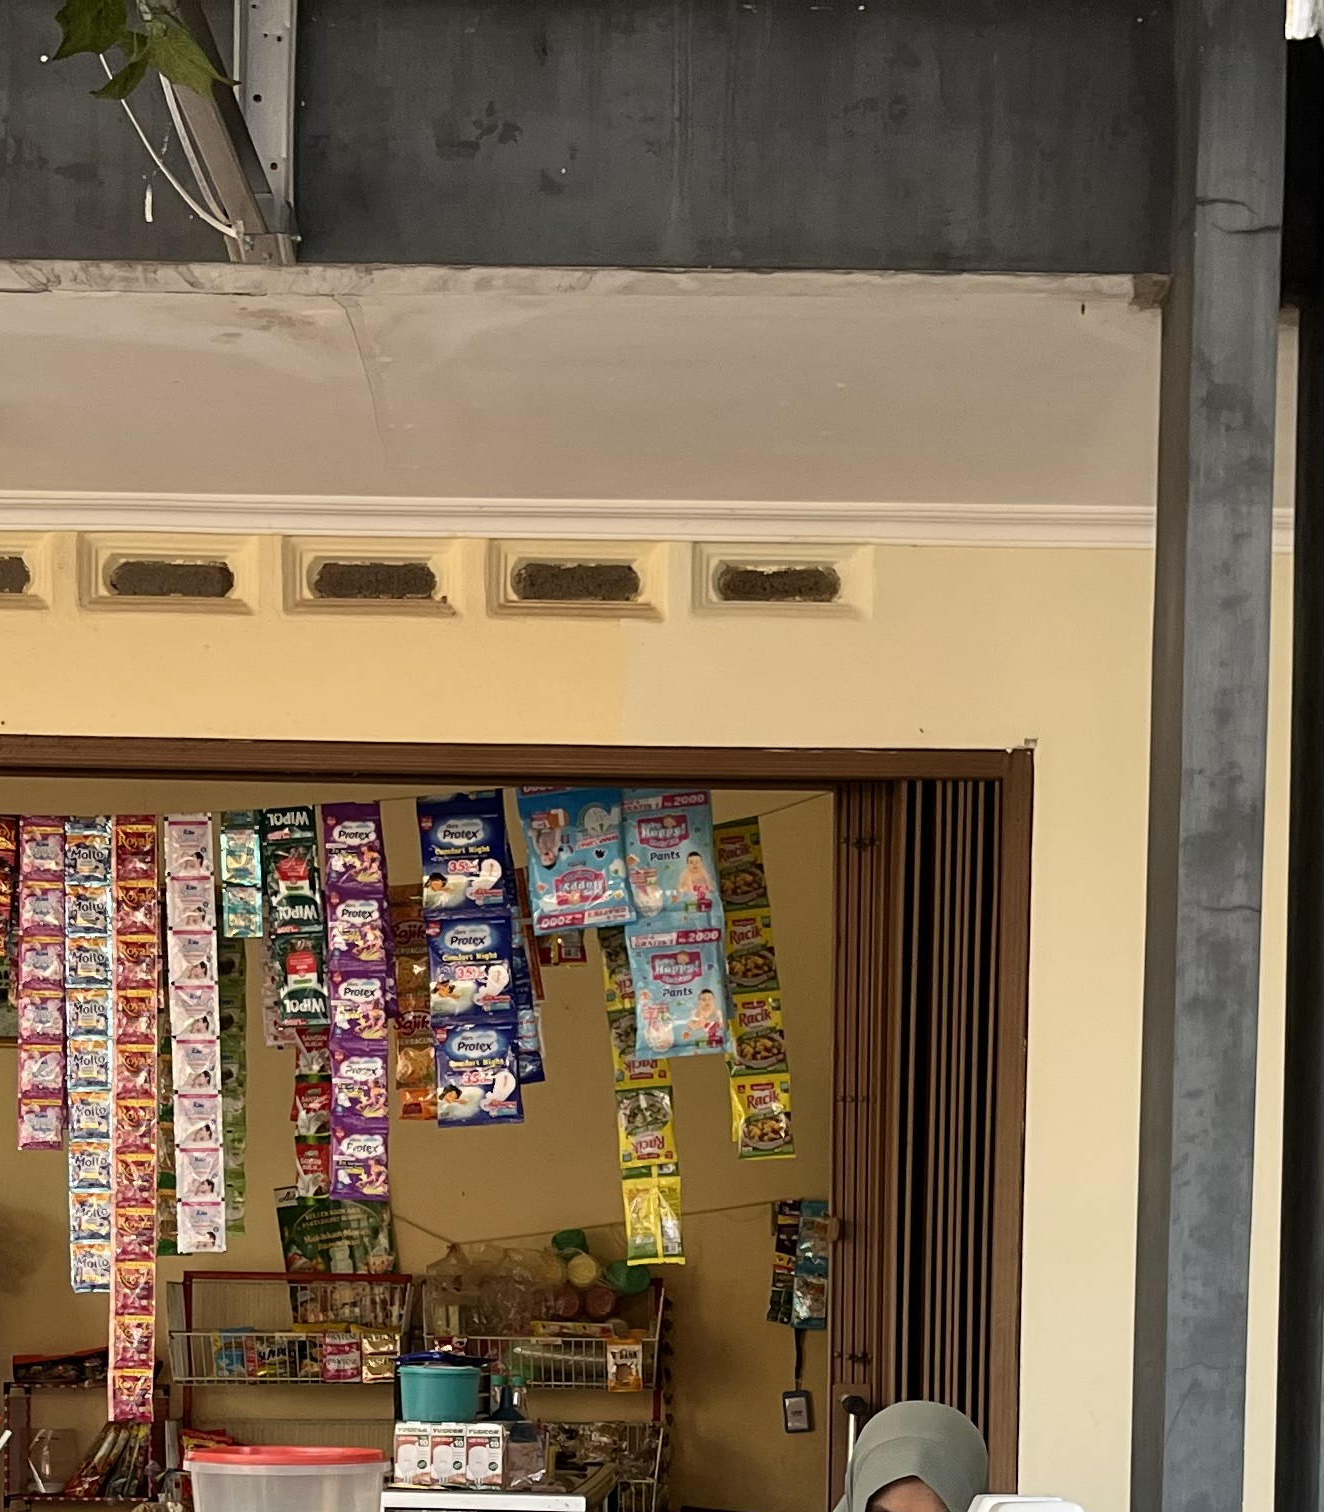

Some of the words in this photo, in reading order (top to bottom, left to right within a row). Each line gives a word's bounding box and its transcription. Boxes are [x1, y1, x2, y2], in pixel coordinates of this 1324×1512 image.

[267, 811, 309, 826] WIPOL
[338, 830, 371, 840] Protex
[443, 829, 479, 840] Protex
[650, 851, 681, 861] Pants
[718, 841, 751, 862] Racik
[341, 908, 374, 919] Protex
[541, 914, 574, 929] 2000
[392, 923, 427, 945] Sajik
[450, 935, 486, 946] Protex
[688, 932, 719, 943] 2000
[729, 925, 763, 944] Racik
[343, 987, 376, 998] Protex
[662, 988, 694, 998] Pants
[284, 997, 325, 1013] WIPOL
[739, 1007, 772, 1027] Racik
[393, 1016, 430, 1036] Sajik
[457, 1040, 494, 1051] Protex
[747, 1090, 780, 1109] Racik
[632, 1135, 665, 1153] Racik
